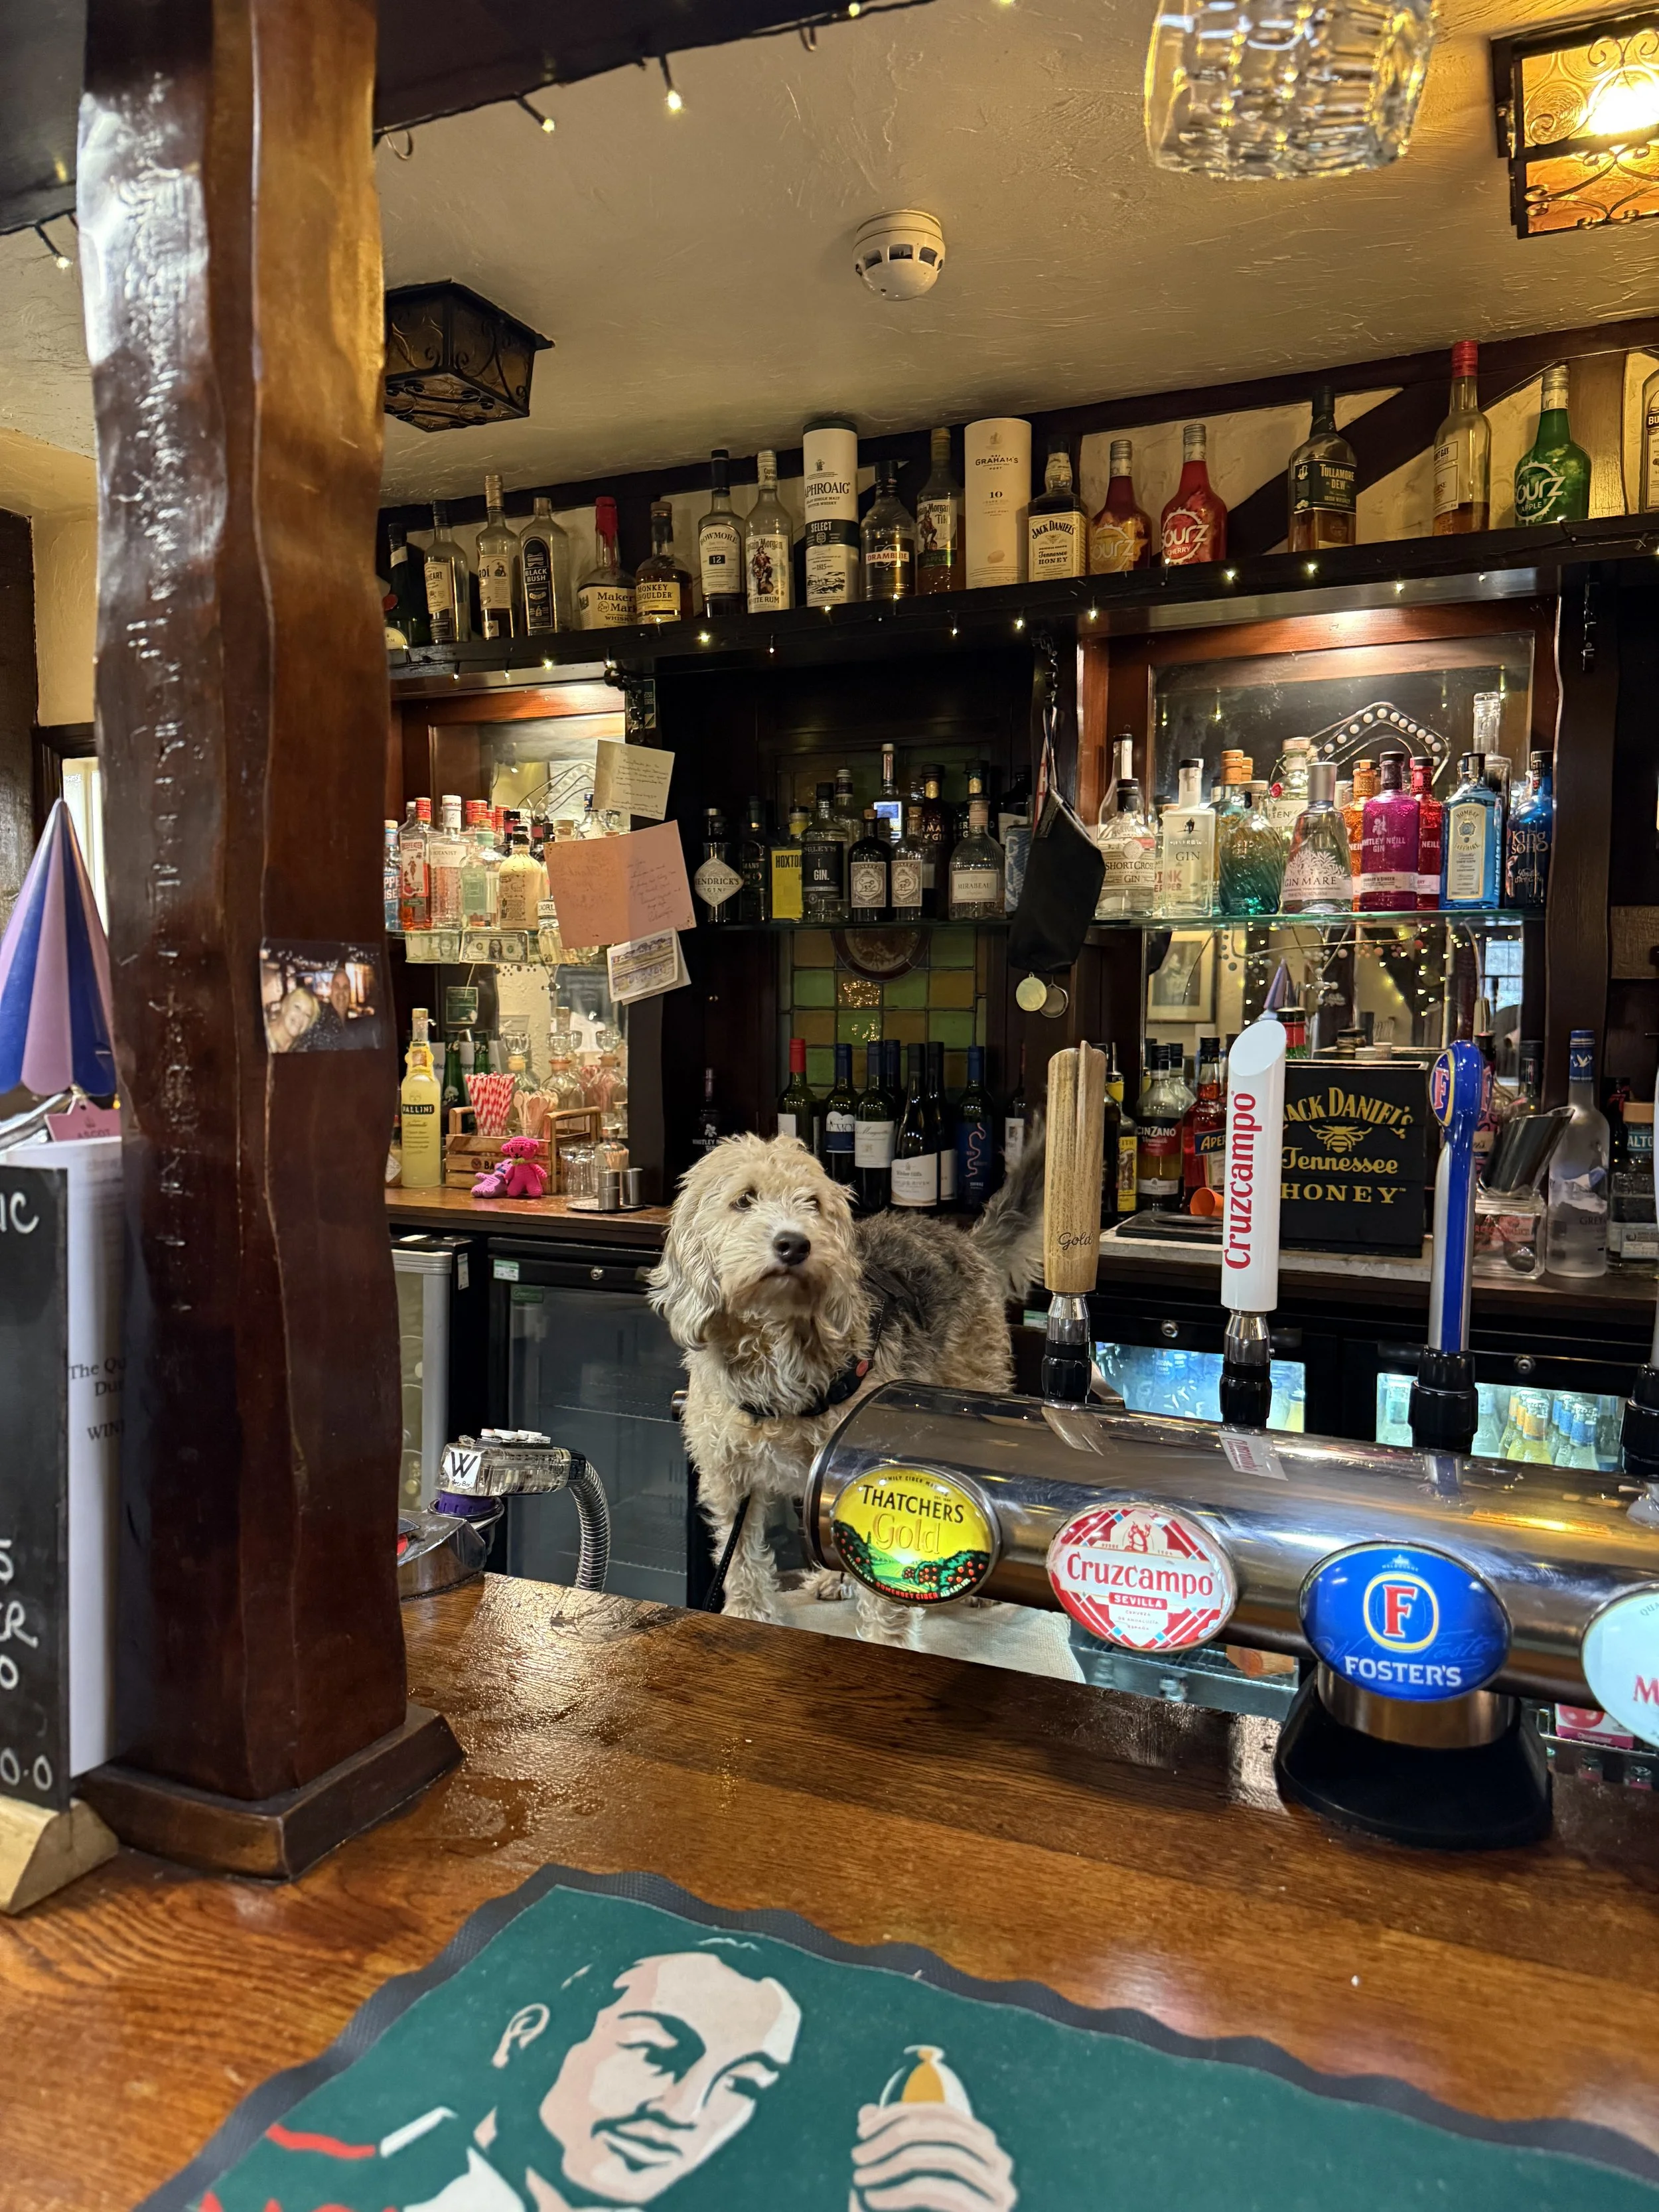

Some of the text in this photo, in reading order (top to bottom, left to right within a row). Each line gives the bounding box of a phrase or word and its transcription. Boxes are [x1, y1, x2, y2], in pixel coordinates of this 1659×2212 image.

[975, 457, 1019, 466] GRAHAM'S
[1319, 463, 1354, 482] TULLAMORE
[1331, 479, 1346, 490] DEW
[1515, 476, 1566, 504] ourz
[811, 522, 832, 533] SELECT
[1032, 524, 1048, 539] JACK
[700, 532, 737, 546] BOWMORE
[1092, 539, 1135, 559] ourz
[1168, 546, 1191, 555] CHERRY
[525, 567, 547, 577] BLACK
[637, 584, 668, 593] MONKEY
[637, 592, 672, 601] OULDER
[1386, 836, 1406, 845] NEILL
[1421, 840, 1440, 849] NEILL
[1175, 851, 1200, 861] GIN
[1105, 862, 1133, 871] SHORT
[1123, 875, 1141, 883] GIN
[1284, 876, 1338, 887] GIN MARE
[1433, 1067, 1449, 1110] F
[1284, 1087, 1414, 1140] ACK DANIEL'S
[1136, 1126, 1177, 1138] CINZANO
[484, 1161, 495, 1170] BA
[1282, 1146, 1399, 1175] Tennessee
[1224, 1092, 1262, 1270] Cruzcampo
[1281, 1182, 1399, 1204] HONEY
[1058, 1231, 1094, 1251] Gold
[69, 1363, 100, 1380] The
[862, 1484, 964, 1524] THATCHERS
[872, 1513, 941, 1555] Gold
[1066, 1552, 1214, 1599] Cruzcampo
[1114, 1594, 1163, 1609] SEVILLA
[1382, 1584, 1418, 1639] F
[1343, 1655, 1463, 1688] FOSTER'S
